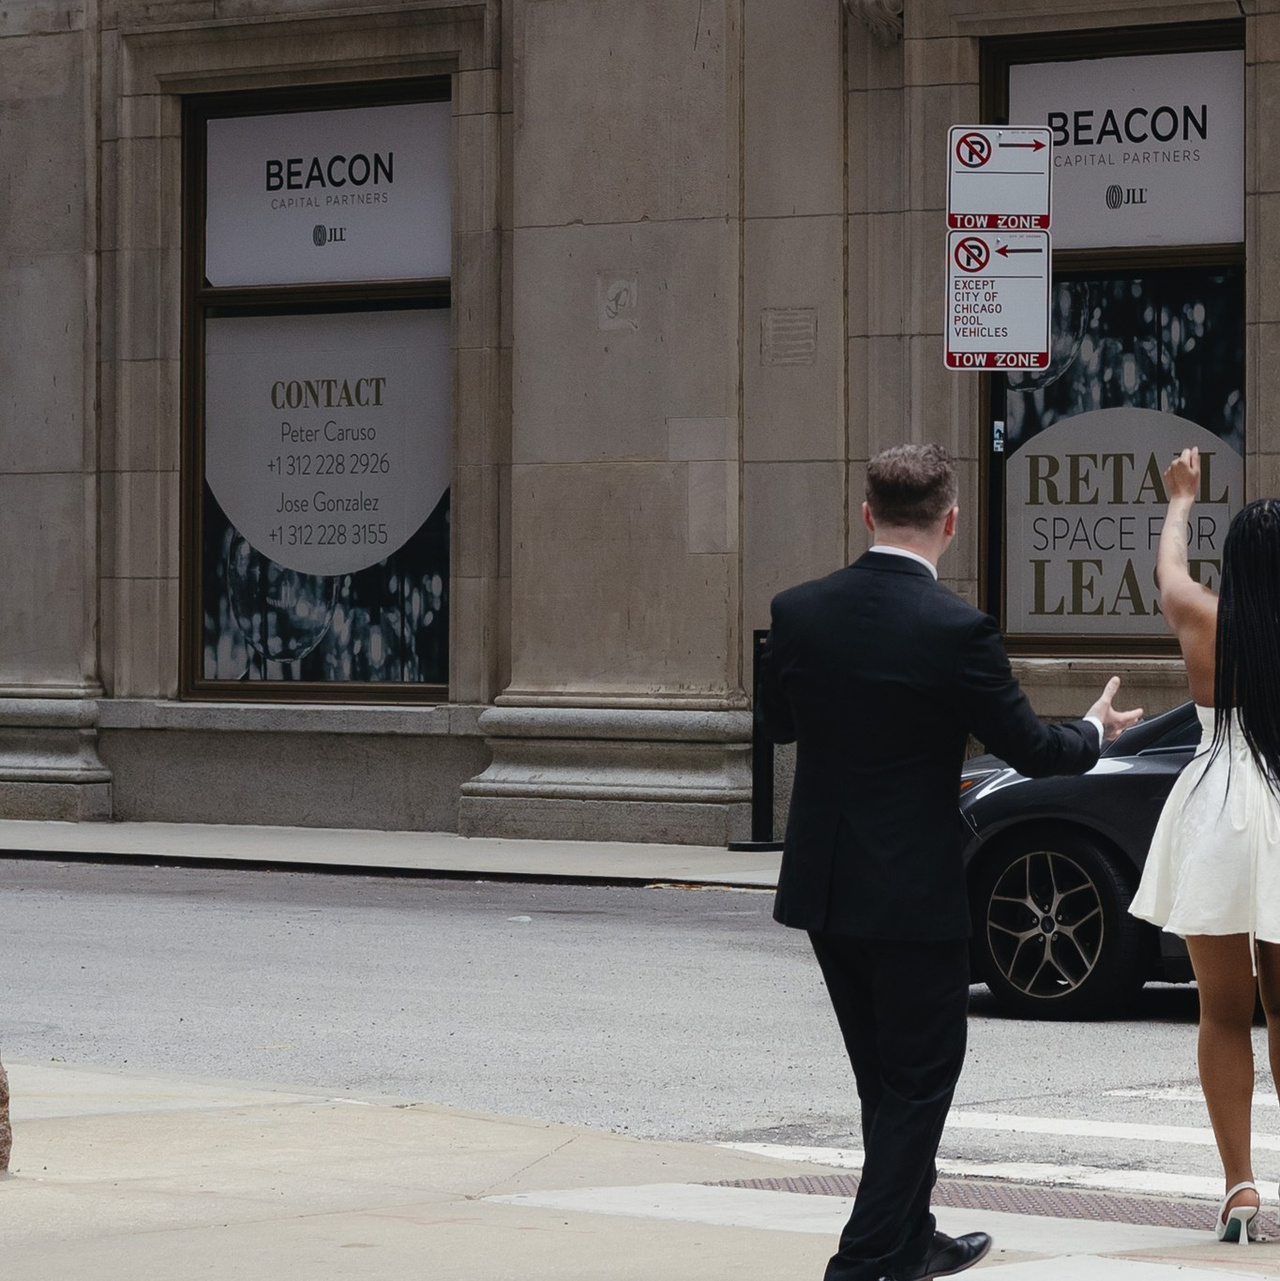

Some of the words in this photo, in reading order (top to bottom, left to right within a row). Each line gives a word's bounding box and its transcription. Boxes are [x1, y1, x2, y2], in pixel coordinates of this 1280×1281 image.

[1047, 104, 1207, 147] BEACON
[1053, 153, 1116, 168] CAPITAL
[1122, 149, 1201, 164] PARTNERS
[266, 152, 394, 192] BEACON
[271, 197, 320, 210] CAPITAL
[326, 192, 389, 206] PARTNERS
[954, 215, 989, 228] TOW
[997, 215, 1041, 229] ZONE
[954, 280, 995, 290] EXCEPT
[954, 292, 979, 302] CITY
[984, 292, 998, 302] OF
[954, 304, 1002, 314] CHICAGO
[954, 316, 983, 325] POOL
[954, 327, 1008, 337] VEHICLES
[952, 353, 987, 367] TOW
[994, 354, 1040, 367] ZONE
[271, 377, 386, 409] CONTACT
[281, 422, 320, 443] Peter
[324, 421, 376, 441] Caruso
[267, 456, 281, 475] +1
[286, 454, 311, 475] 312
[316, 453, 345, 475] 228
[350, 452, 390, 474] 2926
[1025, 451, 1230, 506] RETAL
[276, 492, 309, 513] Jose
[313, 490, 379, 512] Gonzalez
[269, 526, 283, 546] +1
[288, 525, 312, 546] 312
[318, 524, 347, 545] 228
[352, 523, 388, 544] 3155
[1033, 517, 1136, 551] SPACE
[1029, 558, 1221, 616] LEA
